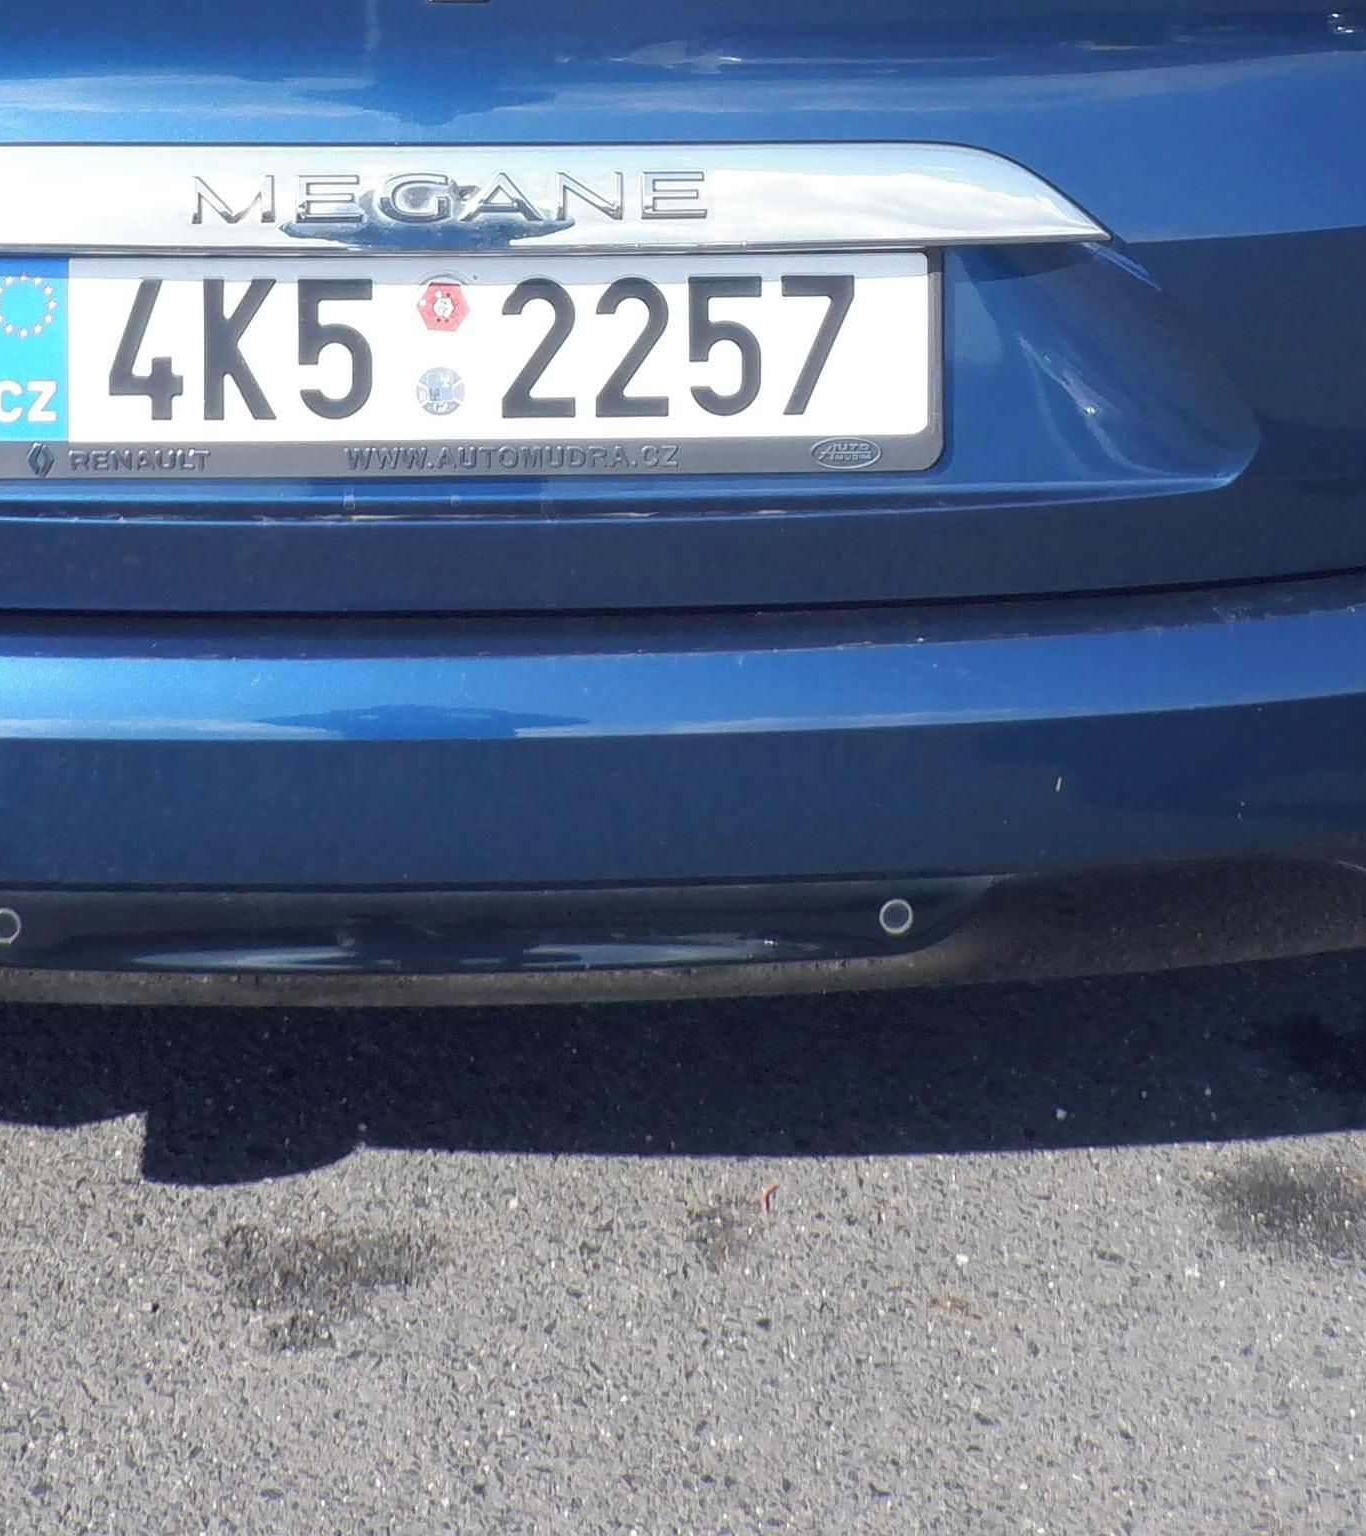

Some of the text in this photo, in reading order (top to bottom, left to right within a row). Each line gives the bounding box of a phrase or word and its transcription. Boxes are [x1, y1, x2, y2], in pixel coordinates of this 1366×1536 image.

[191, 170, 709, 225] MEGANE
[108, 274, 855, 421] 4K5 2257
[67, 449, 212, 472] RENAULT
[343, 445, 680, 470] WWW.AUTOMUDRA.CZ
